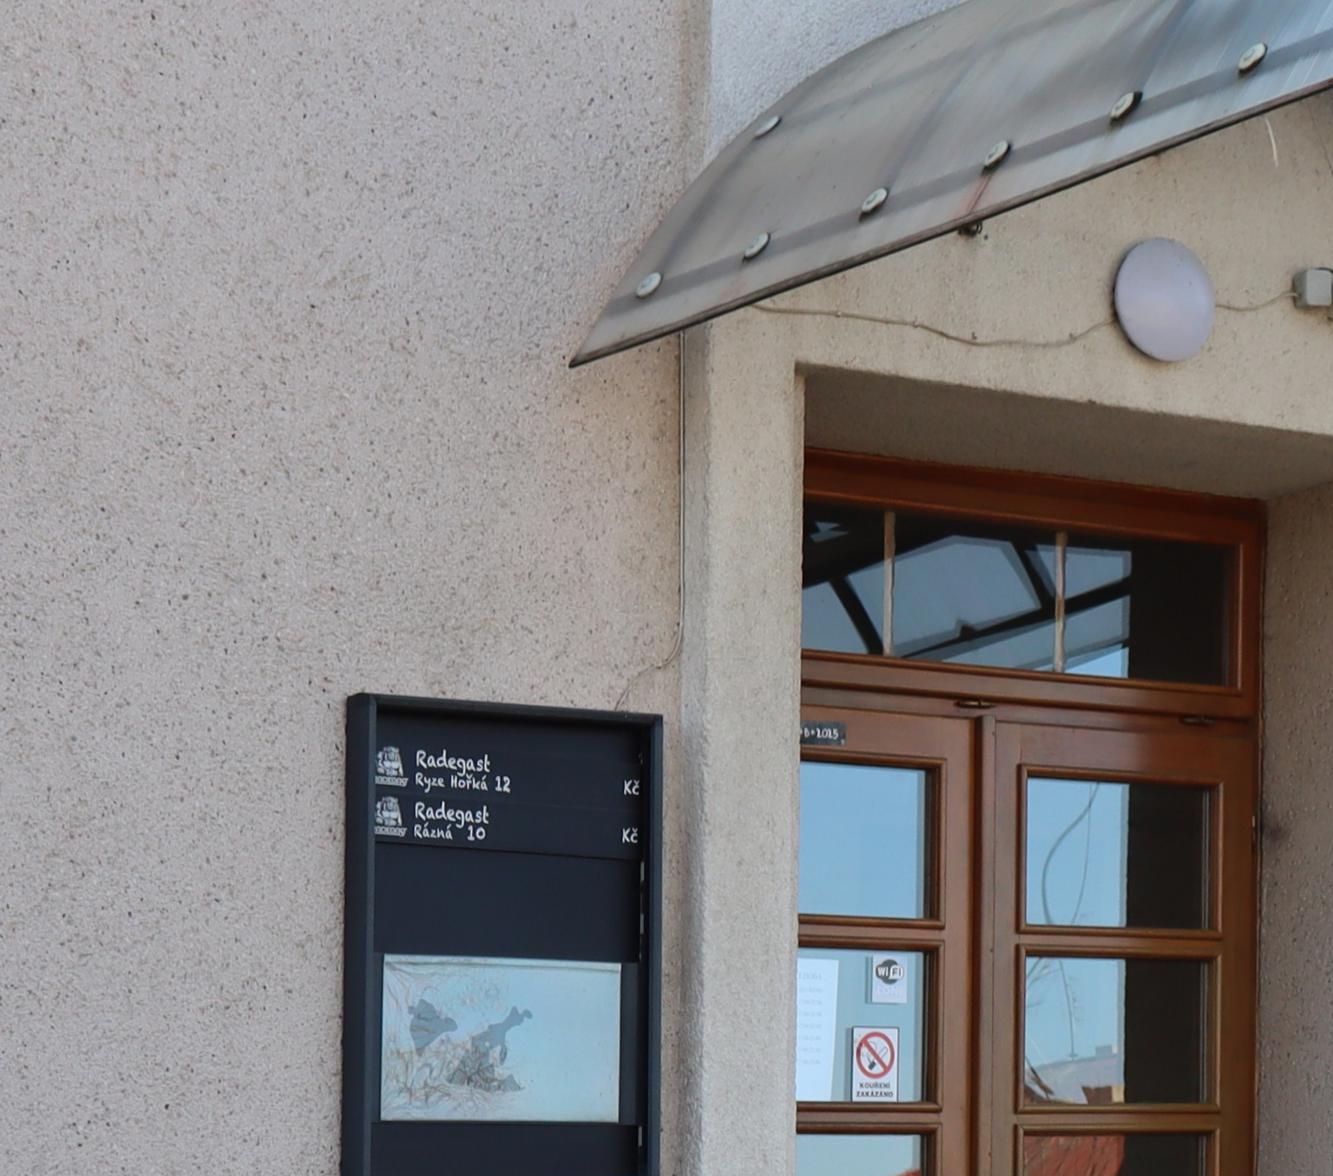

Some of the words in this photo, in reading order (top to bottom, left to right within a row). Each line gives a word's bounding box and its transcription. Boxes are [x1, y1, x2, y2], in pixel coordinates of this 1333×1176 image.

[416, 749, 490, 777] Radegast
[415, 772, 445, 793] Ryze
[451, 774, 488, 792] Hořká
[495, 776, 511, 793] 12
[623, 779, 640, 796] Kč
[414, 800, 489, 829] Radegast
[413, 822, 453, 840] Rázná
[467, 825, 486, 841] 10
[622, 827, 639, 844] Kč
